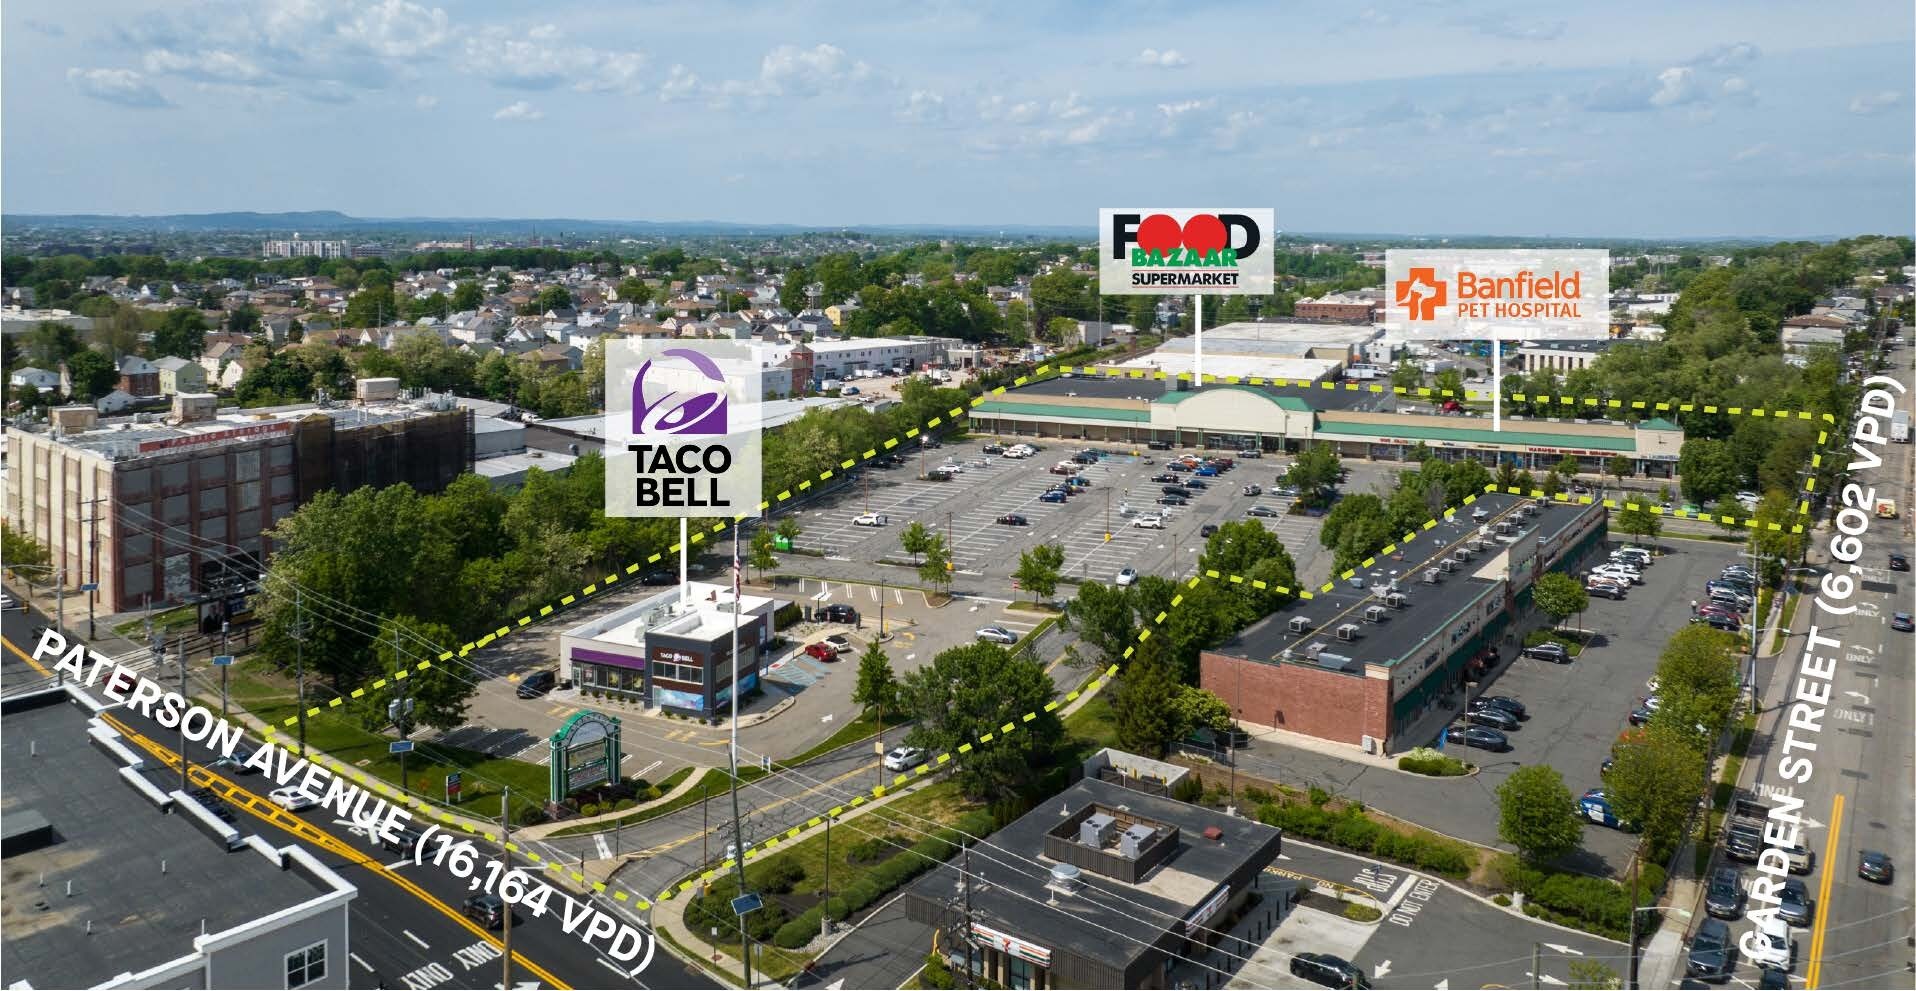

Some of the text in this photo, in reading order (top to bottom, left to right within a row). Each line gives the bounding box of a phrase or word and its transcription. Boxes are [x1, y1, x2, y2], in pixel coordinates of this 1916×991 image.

[1352, 868, 1398, 893] STOP
[1388, 878, 1440, 928] DO NOT ENTER
[452, 940, 504, 971] ONLY
[400, 962, 454, 990] ONLY
